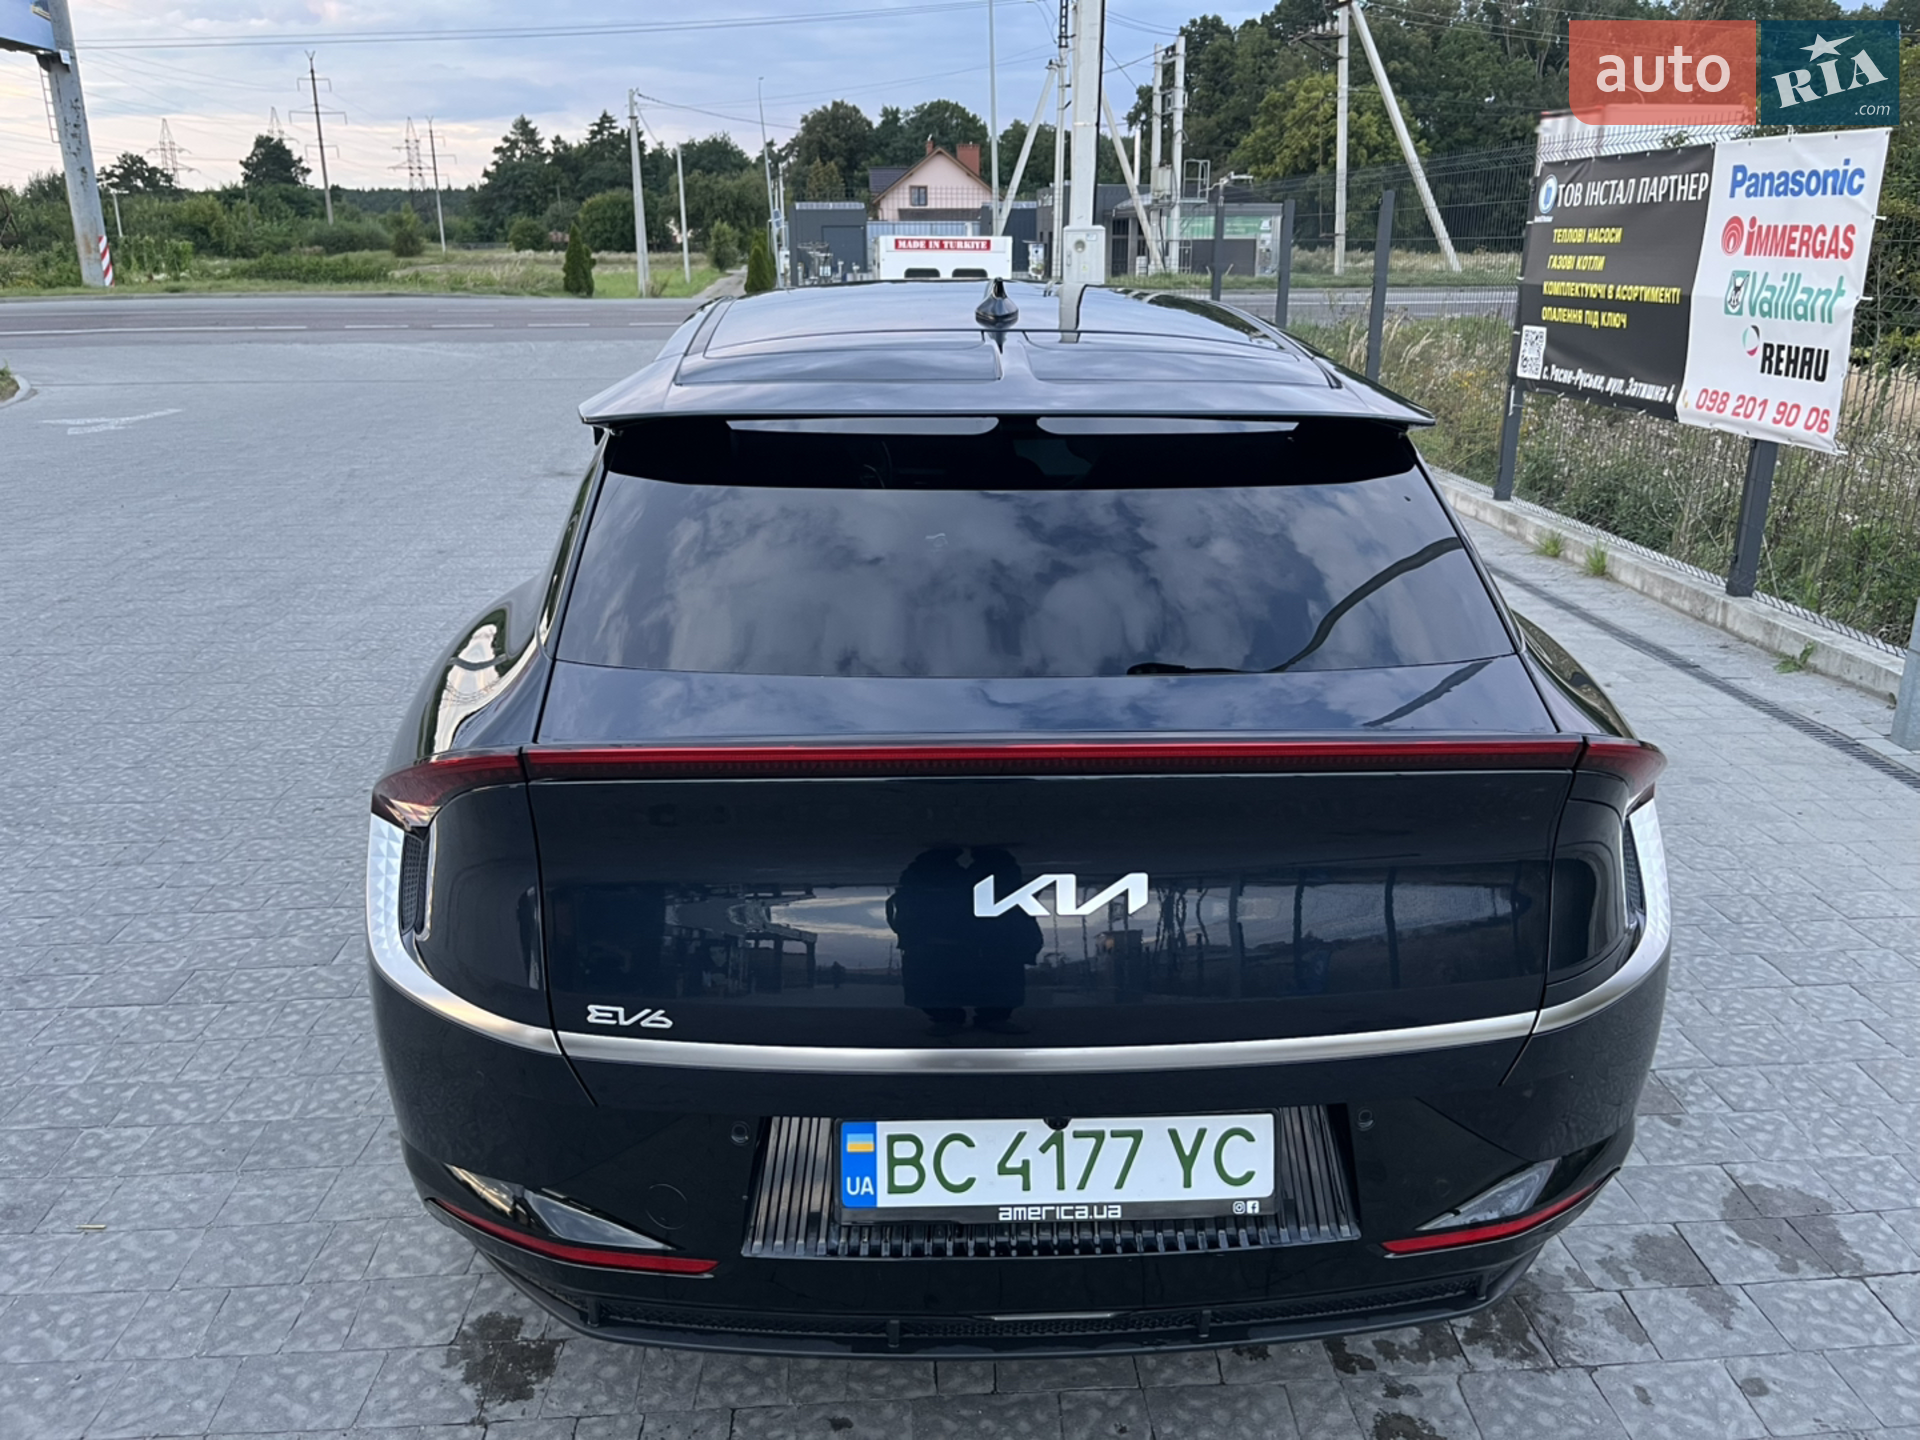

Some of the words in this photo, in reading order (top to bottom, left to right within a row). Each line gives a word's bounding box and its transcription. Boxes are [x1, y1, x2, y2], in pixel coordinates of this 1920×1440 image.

[1557, 182, 1583, 208] ТОВ
[1584, 178, 1636, 206] ІНСТАЛ
[1637, 172, 1709, 203] ПАРТНЕР
[1729, 158, 1866, 198] Panasonic
[897, 240, 926, 249] MADE
[928, 240, 940, 249] IN
[942, 240, 987, 250] TURKIYE
[1553, 228, 1585, 243] ТЕПЛОВІ
[1587, 227, 1623, 243] НАСОСИ
[1547, 255, 1576, 270] ГАЗОВІ
[1576, 255, 1606, 271] КОТЛИ
[1542, 281, 1606, 299] КОМПЛЕКТУЮЧІ
[1607, 284, 1614, 299] В
[1615, 285, 1681, 304] АСОРТИМЕНТІ
[1747, 272, 1846, 324] Vaillant
[1541, 306, 1583, 324] ОПАЛЕННЯ
[1584, 310, 1599, 329] ПІД
[1600, 312, 1627, 329] КЛЮЧ
[1760, 343, 1829, 382] REHAU
[1625, 377, 1667, 402] Затишна
[1696, 388, 1730, 414] 098
[1731, 394, 1769, 421] 201
[1772, 401, 1801, 427] 90
[1803, 406, 1831, 433] 06
[973, 872, 1149, 917] KIA
[586, 1004, 673, 1029] EV6
[886, 1132, 977, 1194] BC
[997, 1129, 1144, 1192] 4177
[1167, 1127, 1257, 1189] YC
[847, 1177, 874, 1196] UA
[998, 1204, 1122, 1221] america.ua
